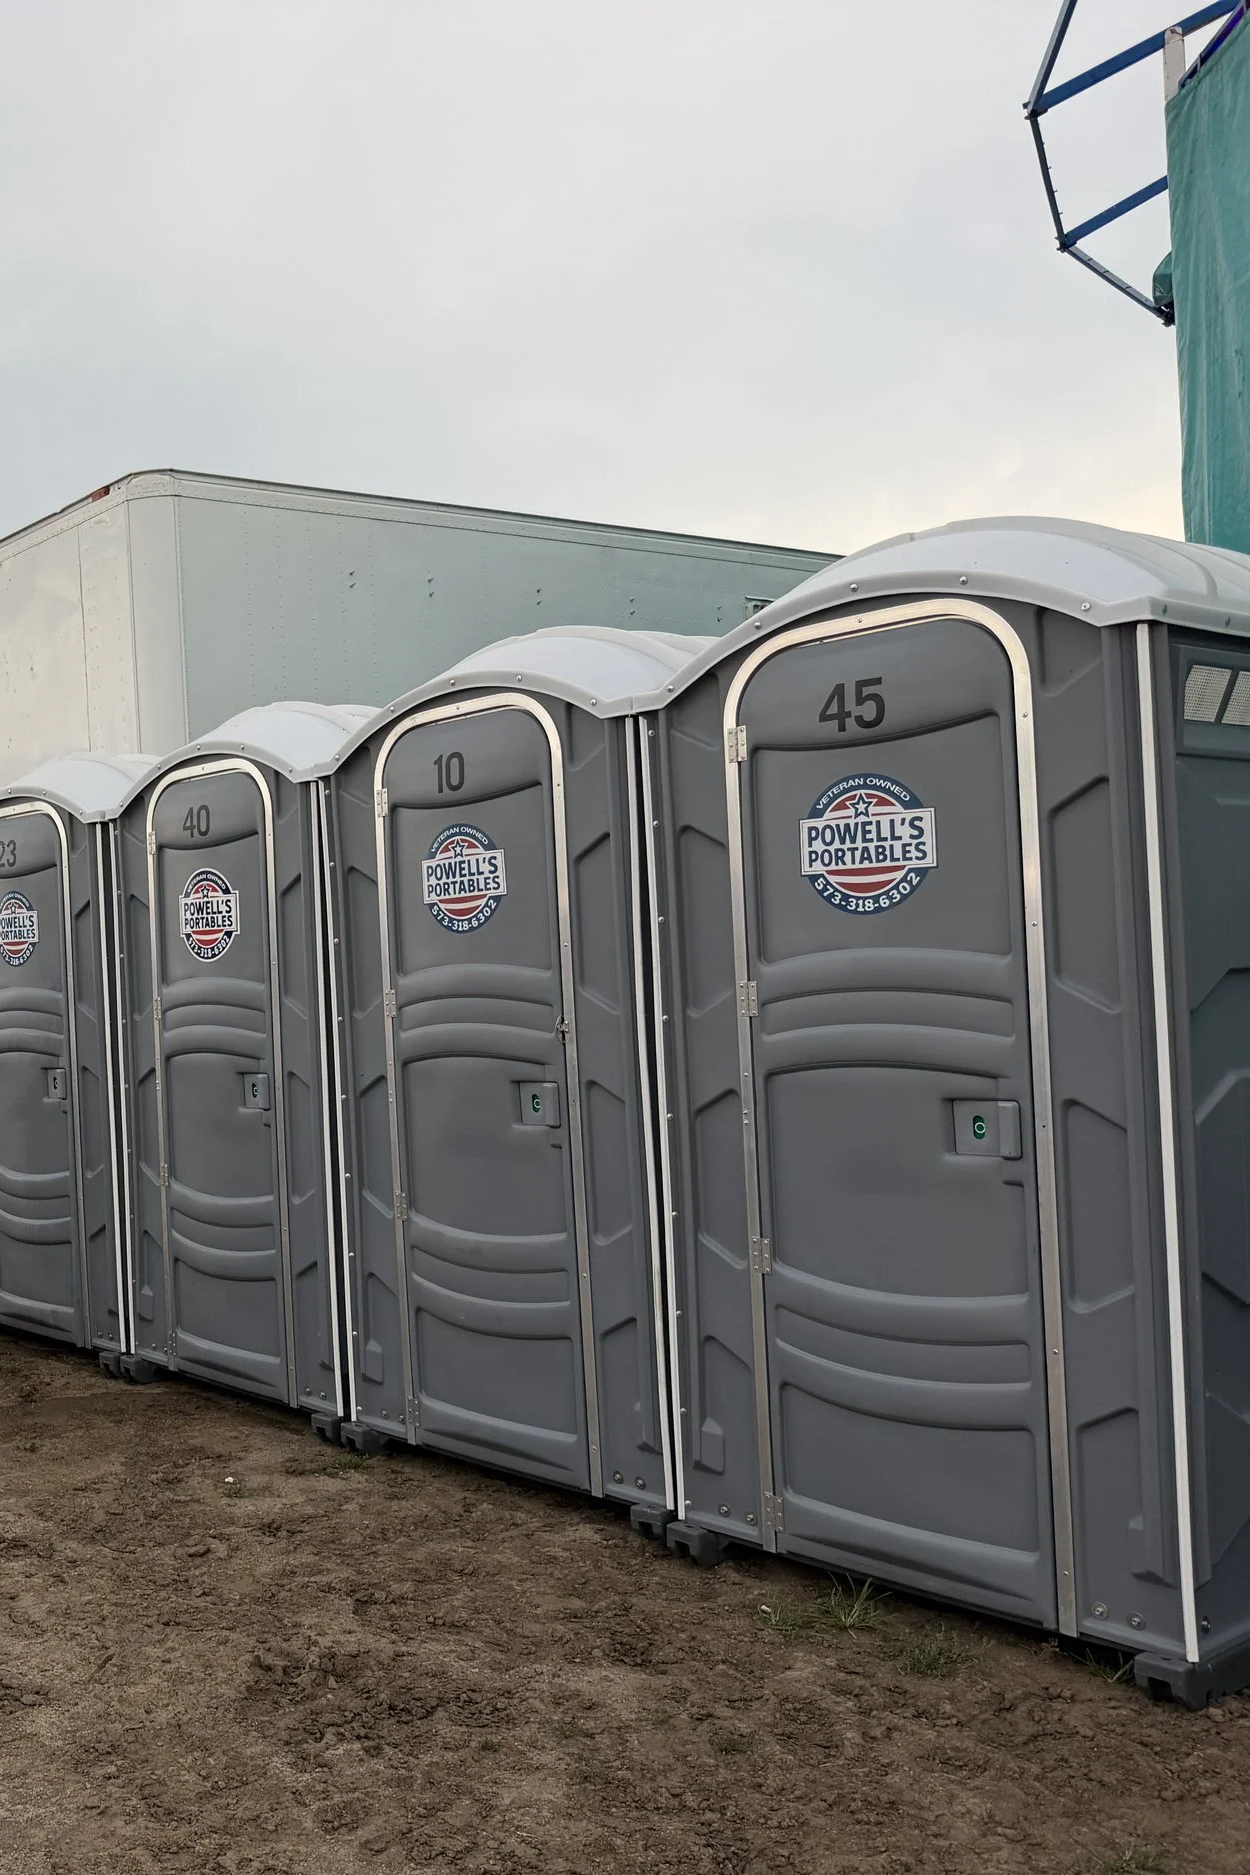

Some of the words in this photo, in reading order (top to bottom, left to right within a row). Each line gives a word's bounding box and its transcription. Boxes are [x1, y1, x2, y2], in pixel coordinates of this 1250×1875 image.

[818, 676, 886, 733] 45
[433, 751, 465, 794] 10
[816, 777, 864, 810] VETERAN
[867, 777, 910, 802] OWNED
[182, 804, 211, 838] 40
[807, 815, 925, 848] POWELL'S
[431, 827, 460, 852] VETERAN
[461, 826, 489, 845] OWNED
[808, 842, 927, 869] PORTABLES
[187, 873, 207, 893] VETERAN
[207, 873, 226, 890] OWNED
[426, 856, 499, 883] POWELL'S
[427, 875, 501, 898] PORTABLES
[814, 871, 921, 912] 573-318-6302
[184, 899, 232, 917] POWELL'S
[431, 899, 497, 931] 573-318-6302
[184, 915, 233, 930] PORTABLES
[188, 935, 230, 958] 573-318-6302
